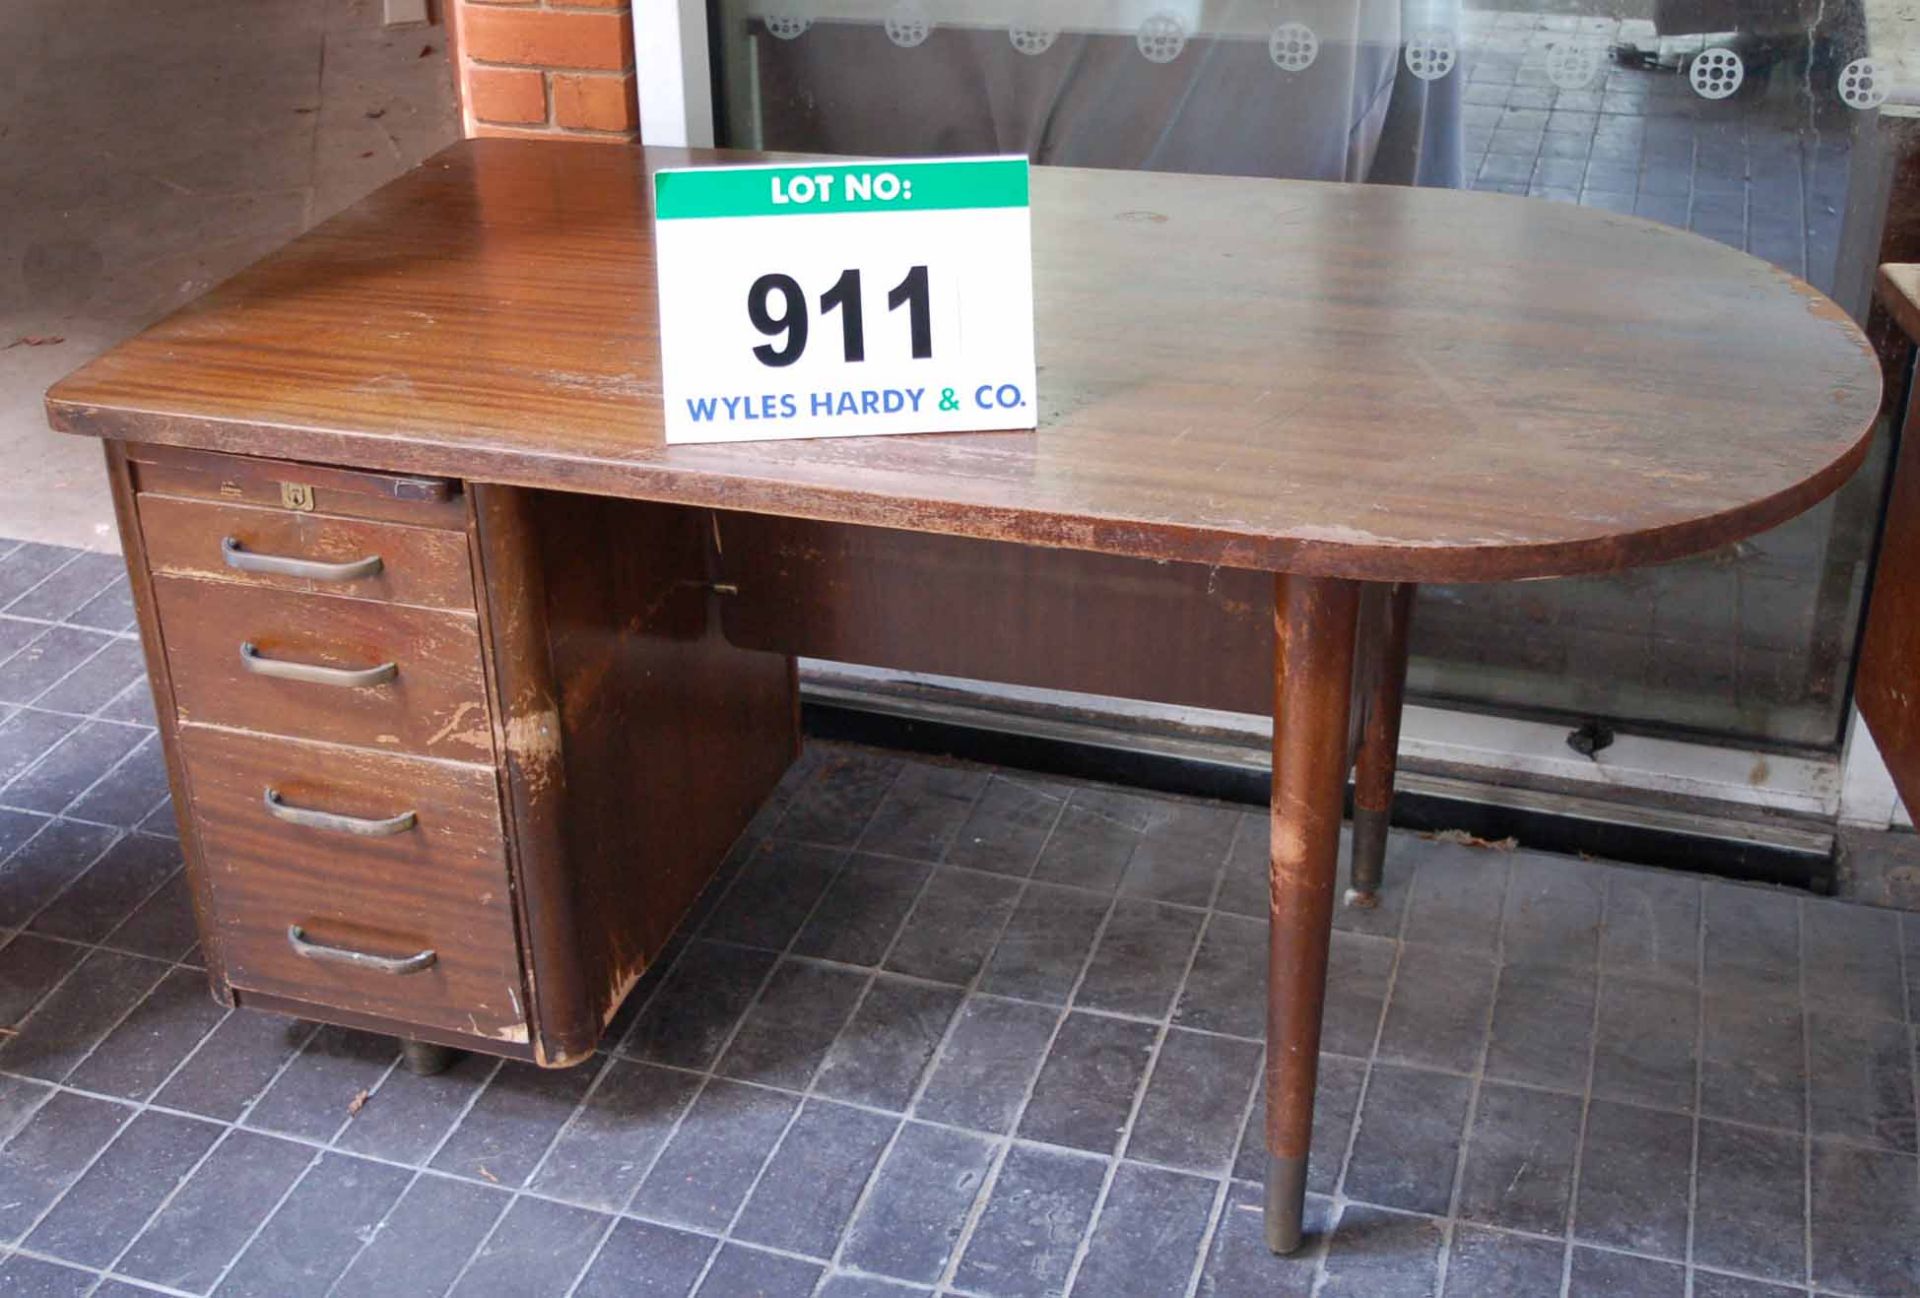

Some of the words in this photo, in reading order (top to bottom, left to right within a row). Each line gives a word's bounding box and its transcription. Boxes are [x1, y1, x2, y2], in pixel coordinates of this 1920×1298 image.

[770, 175, 834, 204] LOT
[845, 172, 912, 201] NO:
[747, 265, 932, 368] 911
[687, 394, 797, 422] WYLES
[810, 388, 926, 417] HARDY
[938, 387, 960, 411] &
[975, 383, 1027, 410] CO.
